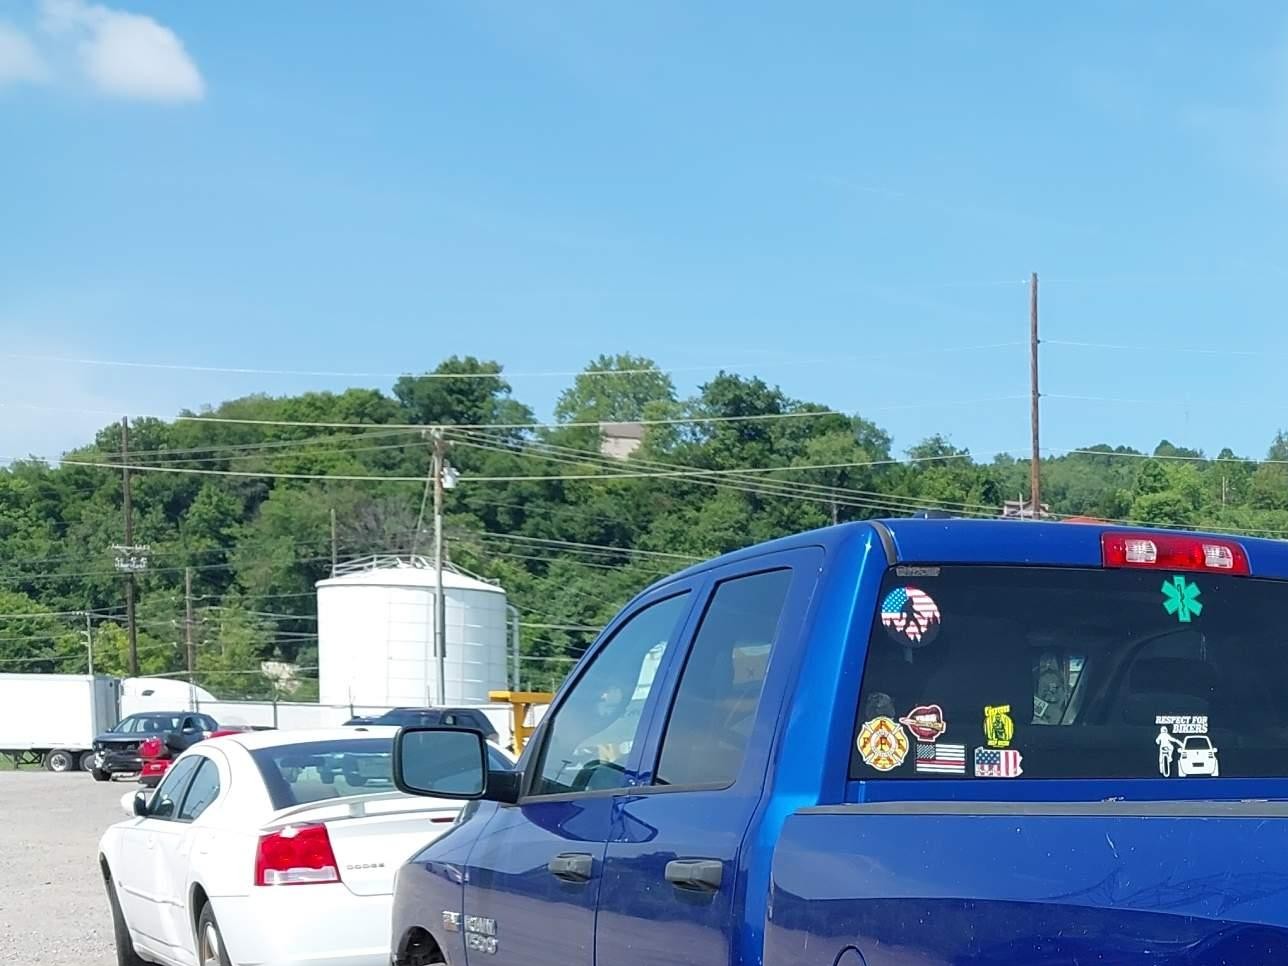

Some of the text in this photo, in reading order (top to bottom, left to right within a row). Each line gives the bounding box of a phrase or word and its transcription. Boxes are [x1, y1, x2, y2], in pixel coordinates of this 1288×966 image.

[1155, 715, 1208, 725] RESPECT FOR
[1172, 723, 1208, 734] BIKERS
